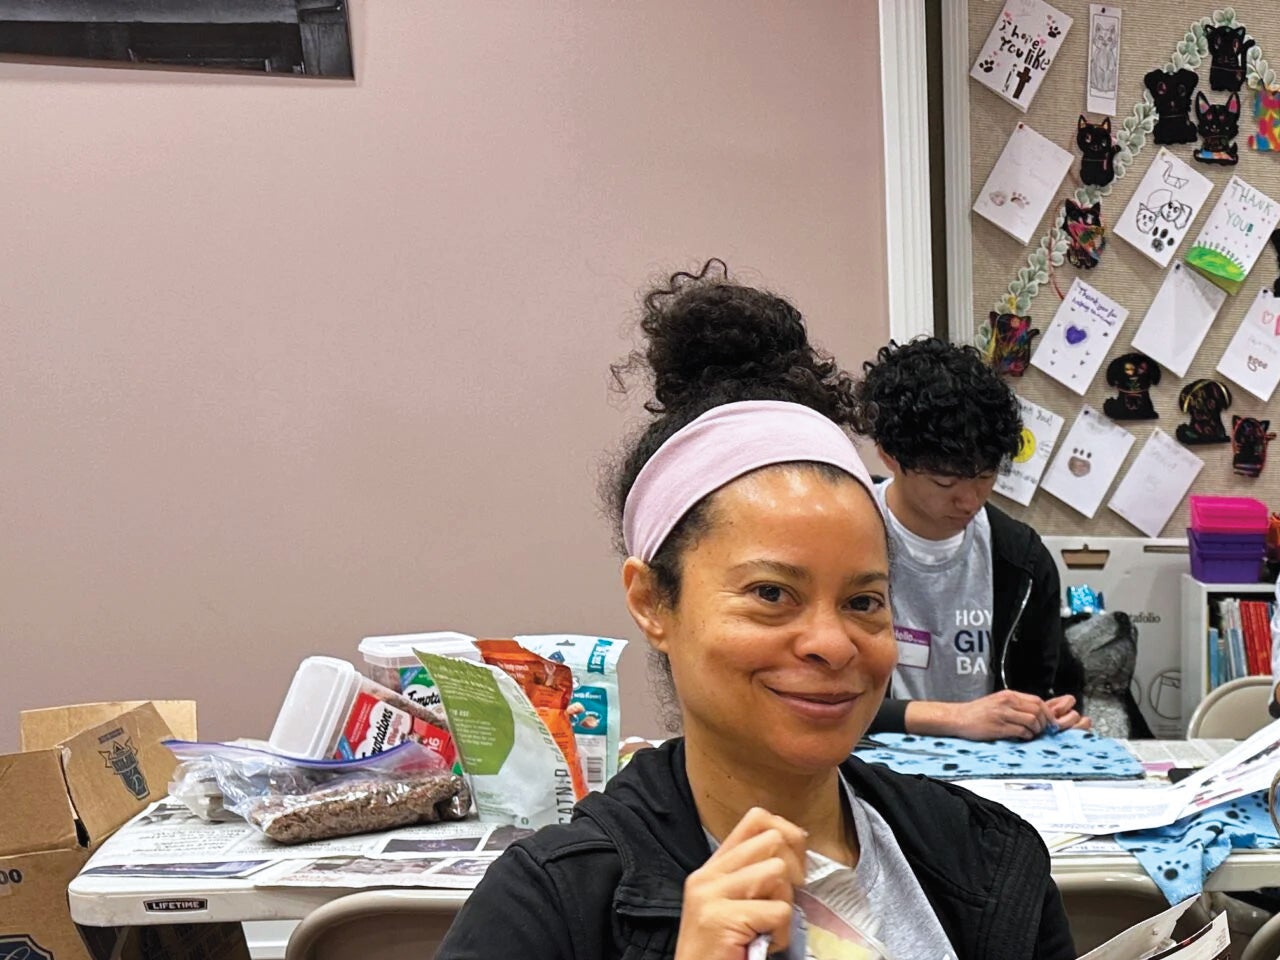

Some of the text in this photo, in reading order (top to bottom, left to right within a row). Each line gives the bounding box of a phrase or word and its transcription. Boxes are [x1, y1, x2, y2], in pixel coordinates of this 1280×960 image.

[1232, 181, 1275, 216] THANK
[1226, 208, 1254, 237] YOU!
[152, 900, 201, 910] LIFETIME
